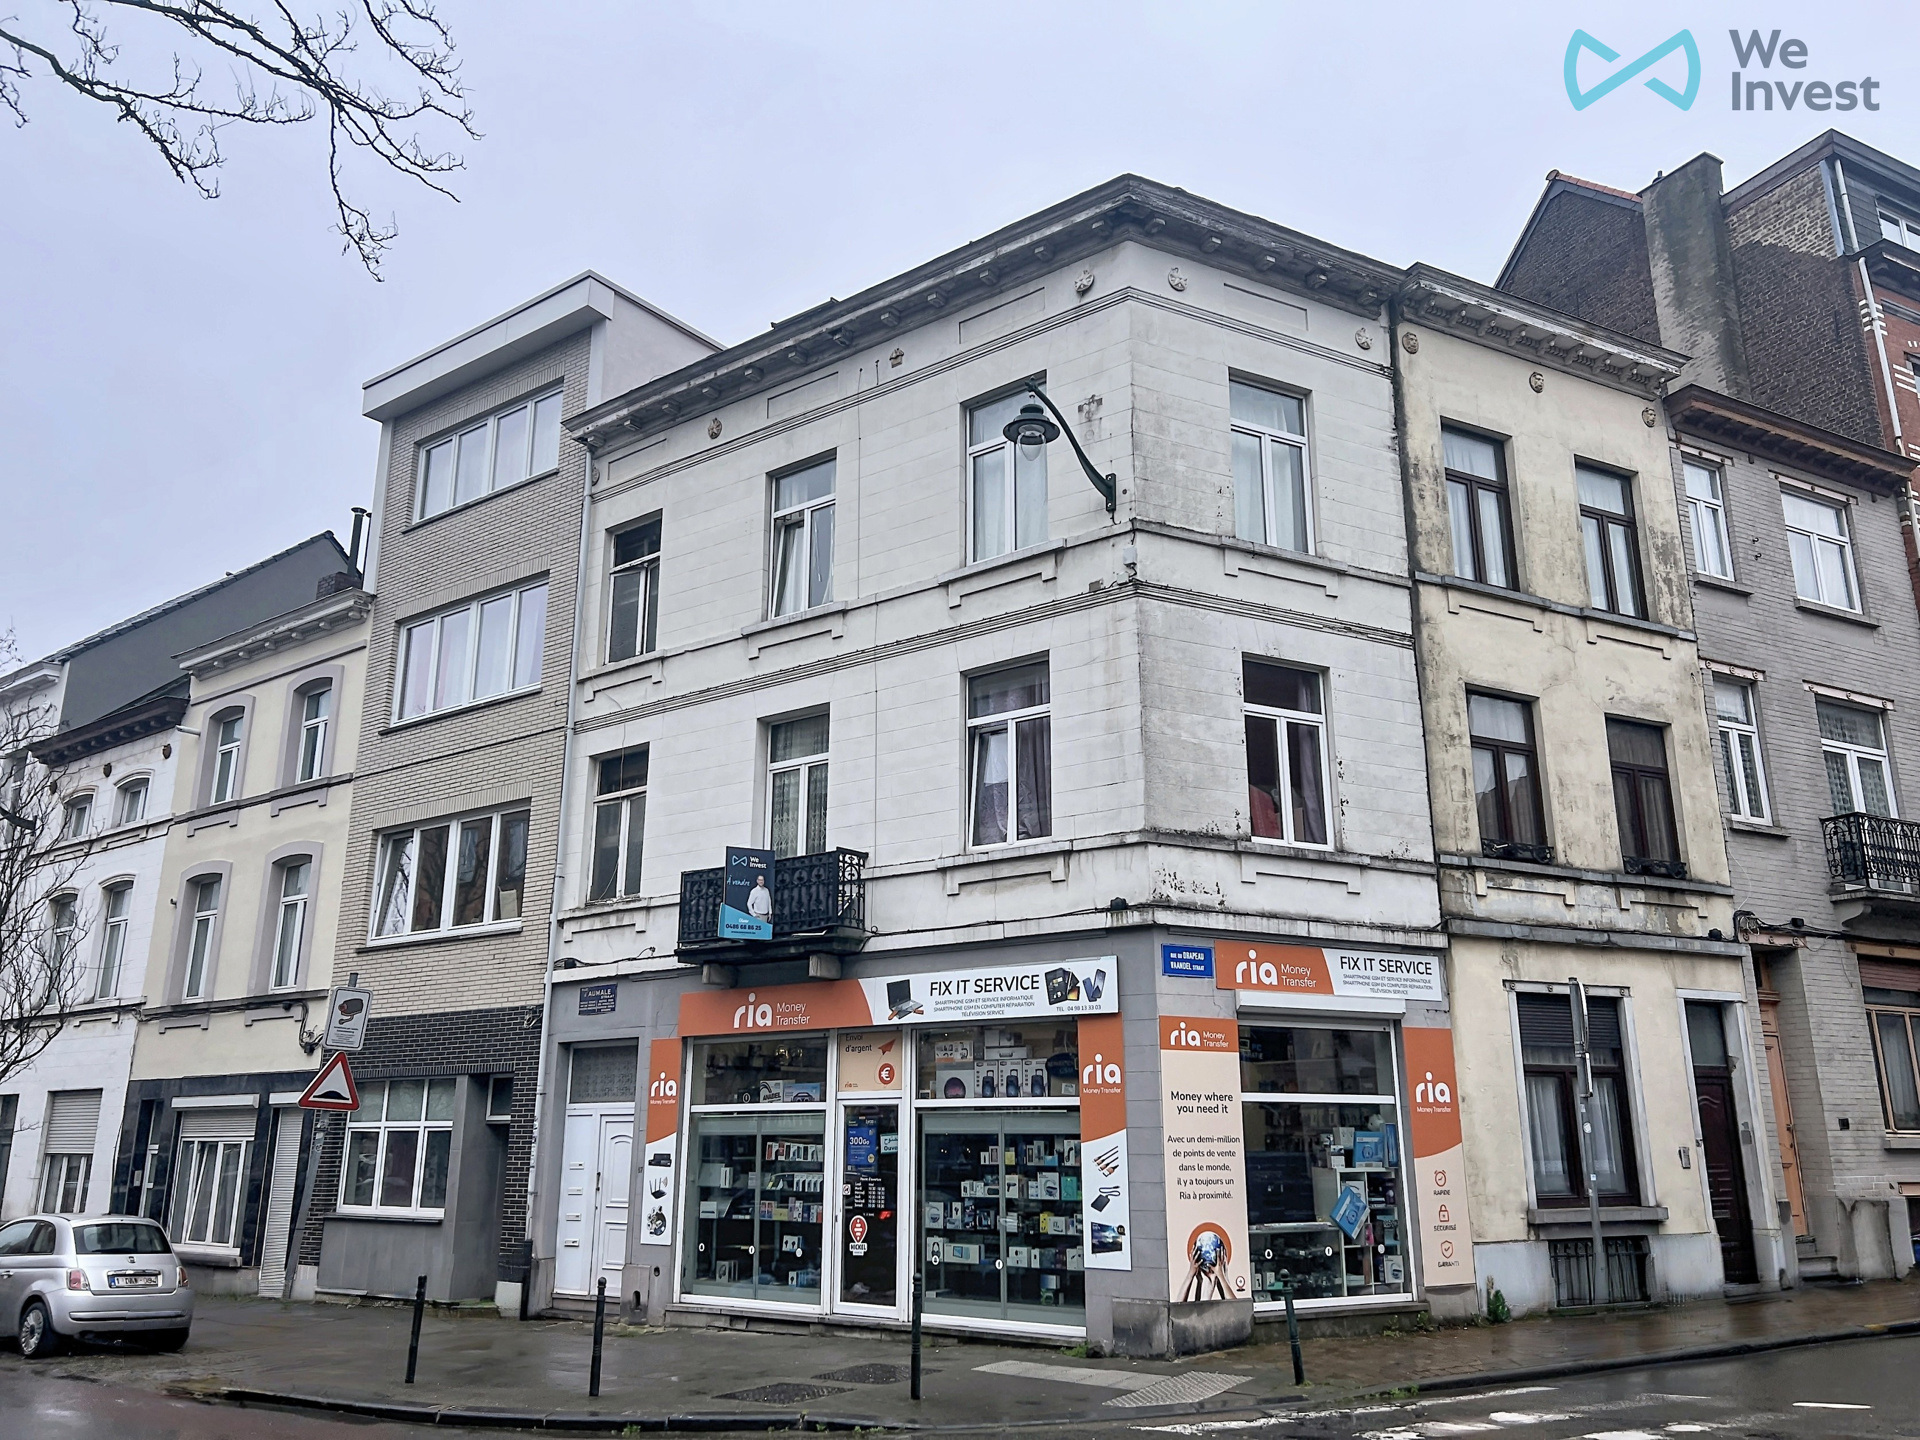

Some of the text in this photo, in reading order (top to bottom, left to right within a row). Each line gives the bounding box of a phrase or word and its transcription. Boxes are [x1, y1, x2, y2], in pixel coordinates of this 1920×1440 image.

[1182, 952, 1204, 960] DRAPEAU
[1236, 949, 1278, 985] ria
[1281, 964, 1310, 977] Money
[1340, 956, 1432, 975] FIX IT SERVICE
[930, 974, 1039, 996] FIX IT SERVICE
[1281, 976, 1316, 988] Transfer
[734, 992, 772, 1028] ria
[776, 1002, 806, 1013] Money
[776, 1014, 810, 1026] Transfer
[1170, 1022, 1200, 1046] ria
[1203, 1031, 1225, 1040] Money
[845, 1044, 872, 1053] d'argent
[1083, 1053, 1121, 1084] ria
[651, 1072, 676, 1096] ria
[1416, 1072, 1451, 1102] ria
[1171, 1091, 1233, 1103] Money where
[1177, 1104, 1228, 1115] you need it
[850, 1137, 870, 1145] 300Go
[1197, 1135, 1240, 1143] demi-million
[1183, 1149, 1205, 1158] points
[1206, 1163, 1232, 1172] monde,
[1195, 1178, 1224, 1186] toujours
[1199, 1191, 1233, 1201] proximité.
